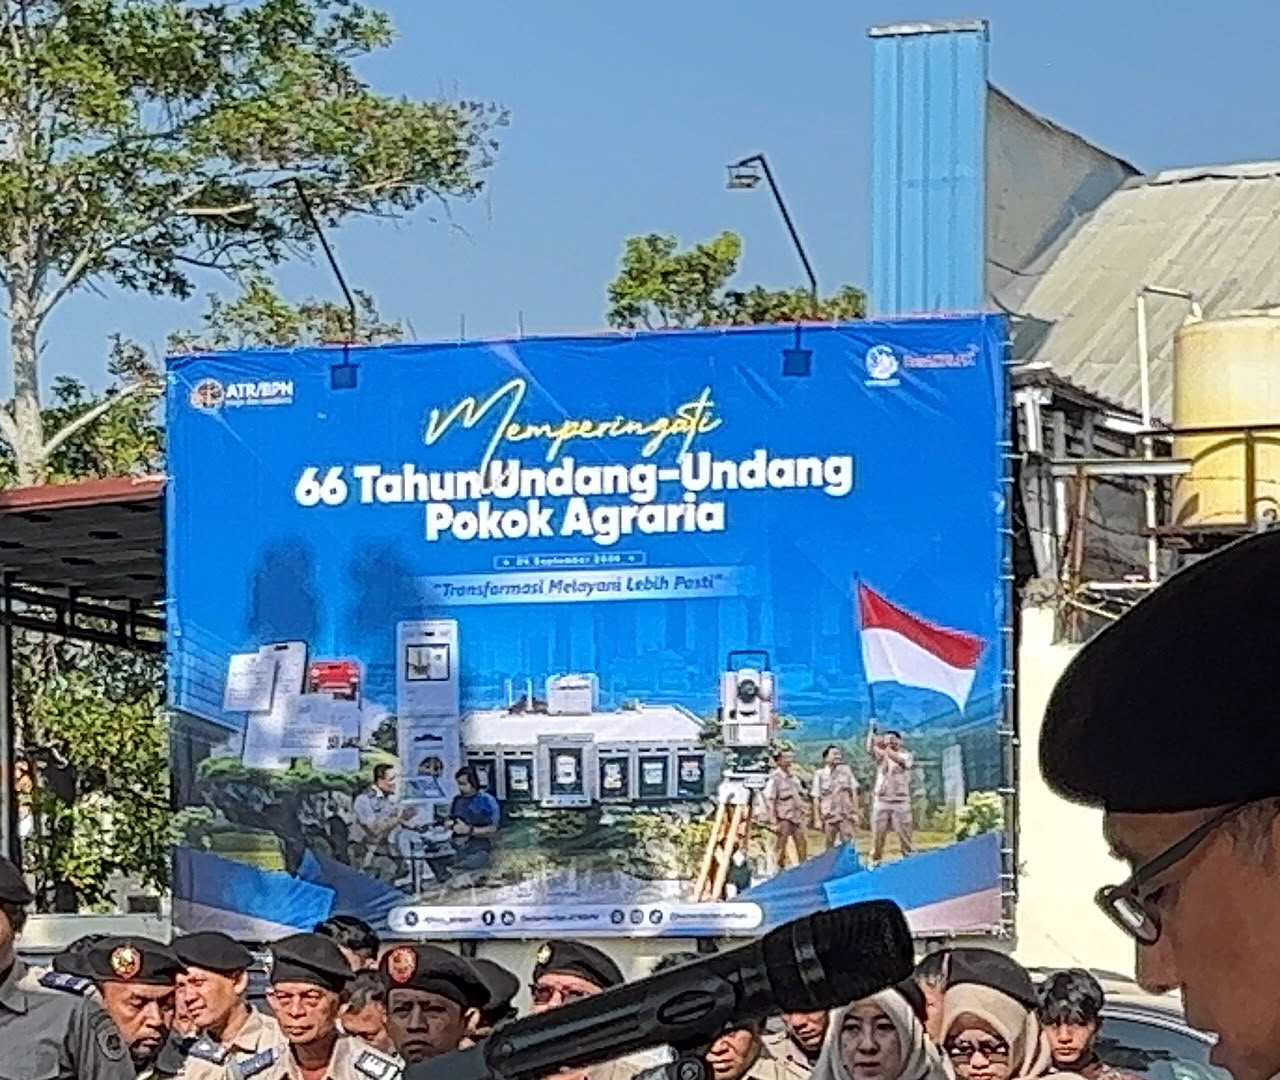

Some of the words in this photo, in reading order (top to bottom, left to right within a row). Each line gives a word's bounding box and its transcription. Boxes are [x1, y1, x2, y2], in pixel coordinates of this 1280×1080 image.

[226, 380, 294, 398] ATR/BPN
[425, 377, 723, 493] Memperingati
[295, 465, 348, 506] 66
[353, 462, 483, 503] Tahun
[488, 449, 853, 504] Undang-Undang
[425, 498, 555, 542] Pokok
[559, 492, 725, 546] Agraria
[549, 577, 622, 598] Melayani
[626, 575, 669, 592] Lebih
